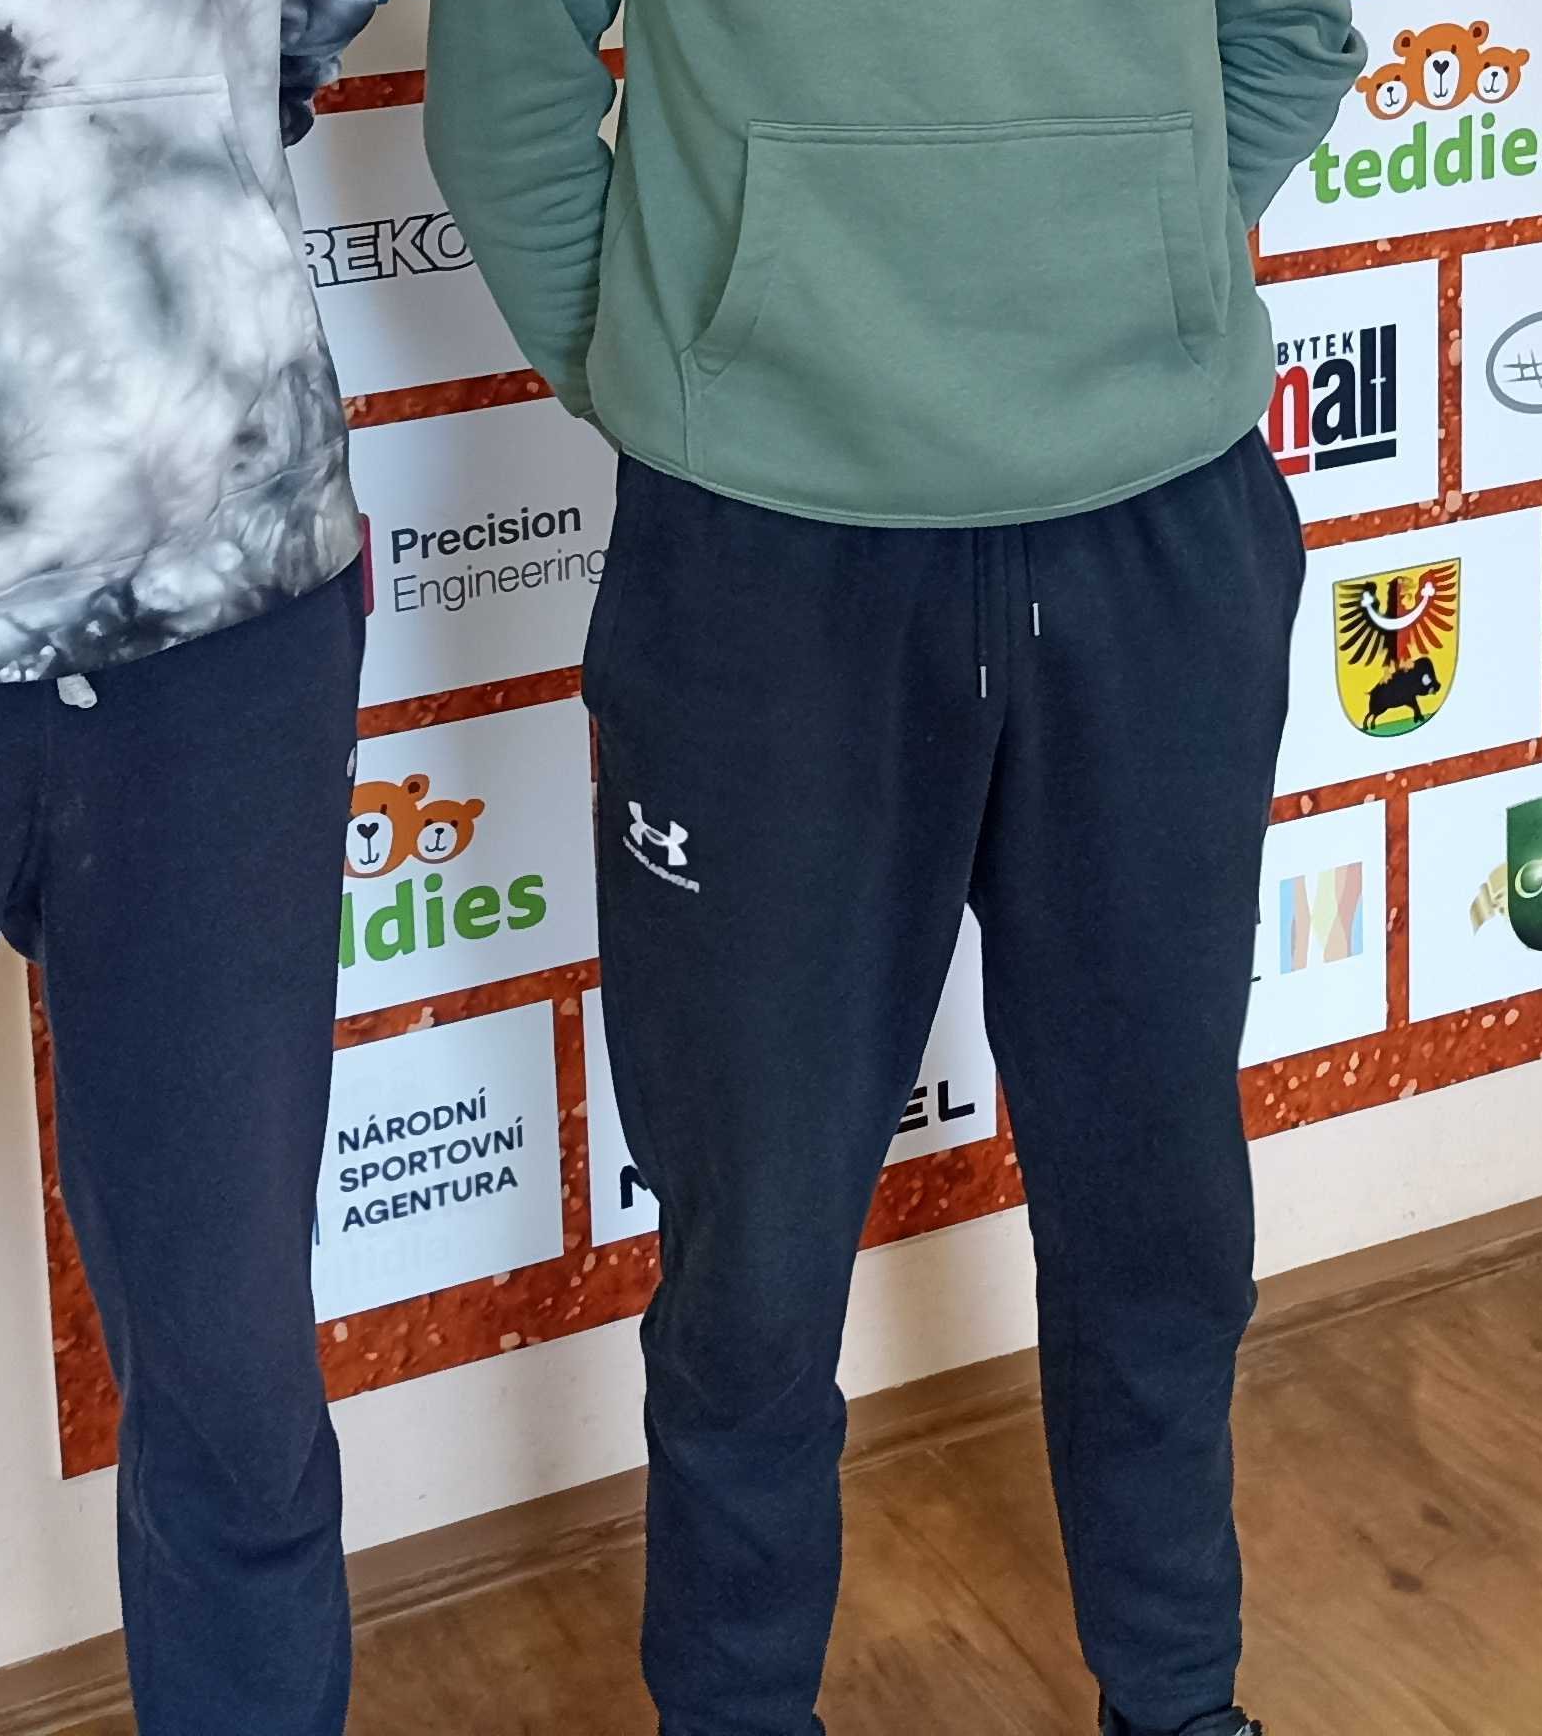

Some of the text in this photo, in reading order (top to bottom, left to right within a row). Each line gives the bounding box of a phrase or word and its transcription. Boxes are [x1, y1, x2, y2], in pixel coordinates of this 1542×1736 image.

[303, 211, 476, 288] REKO
[1277, 331, 1354, 366] BYTEK
[391, 506, 582, 564] Precision
[393, 548, 609, 613] Engineering
[338, 1086, 487, 1155] NÁRODNÍ
[339, 1115, 524, 1193] SPORTOVNÍ
[341, 1166, 519, 1233] AGENTURA
